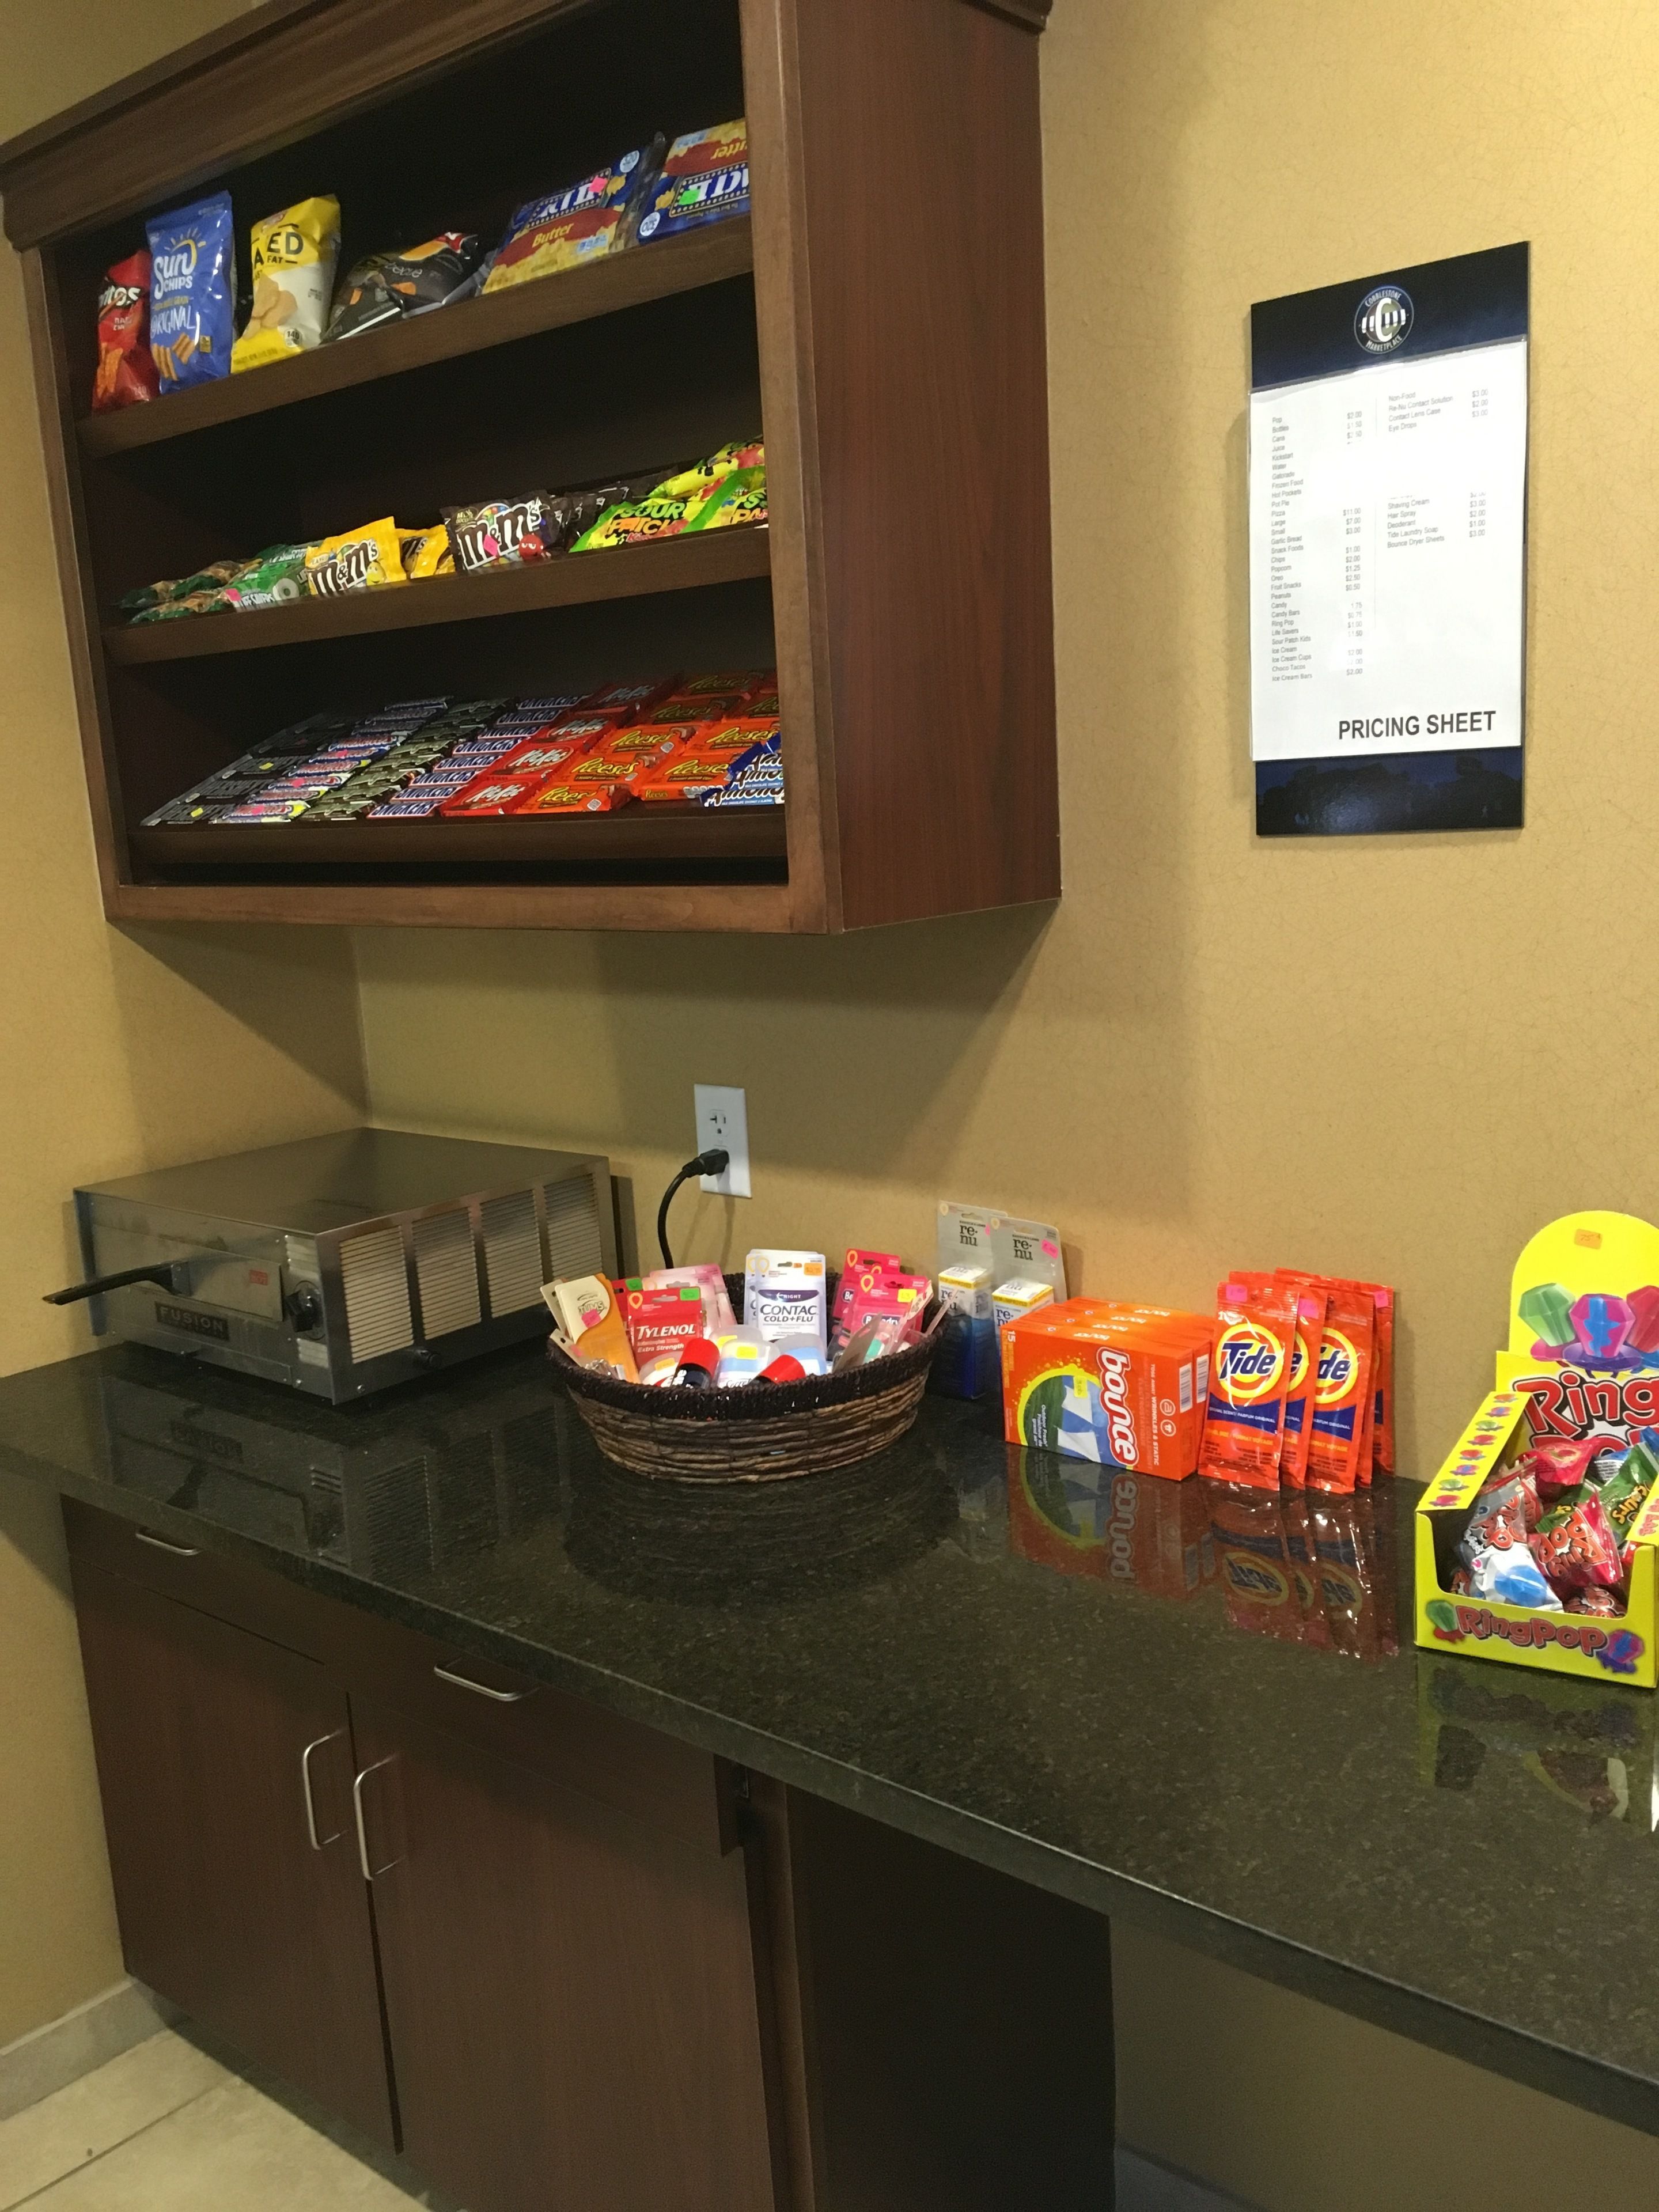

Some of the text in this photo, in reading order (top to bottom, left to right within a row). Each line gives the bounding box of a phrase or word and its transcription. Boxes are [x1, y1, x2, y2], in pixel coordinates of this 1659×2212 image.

[532, 223, 574, 248] Butter
[154, 252, 196, 300] Sun
[164, 275, 192, 290] CHIPS
[1365, 290, 1402, 306] COBBLESTONE
[151, 305, 196, 338] ORIGINAL
[1366, 335, 1402, 351] MARKETPLACE
[1431, 396, 1453, 404] Solution
[1389, 413, 1410, 422] Contact
[621, 502, 686, 519] SOUR
[1388, 502, 1410, 510] Shaving
[1401, 528, 1422, 537] Laundry
[1410, 538, 1424, 546] Dryer
[1339, 711, 1496, 740] PRICING SHEET
[960, 1234, 978, 1246] nu
[1014, 1249, 1033, 1260] nu
[578, 1301, 604, 1315] TUMS
[760, 1304, 817, 1316] CONTAC
[161, 1306, 224, 1332] FUSION
[637, 1324, 696, 1340] TYLENOL
[1008, 1331, 1016, 1342] 15
[637, 1343, 684, 1353] Extra Strength
[1219, 1343, 1277, 1380] Tide
[1317, 1350, 1351, 1380] de
[1101, 1350, 1137, 1461] bounce
[1514, 1372, 1659, 1438] Ring
[1255, 1415, 1276, 1423] ORIGINAL
[1329, 1421, 1350, 1430] ORIGINAL
